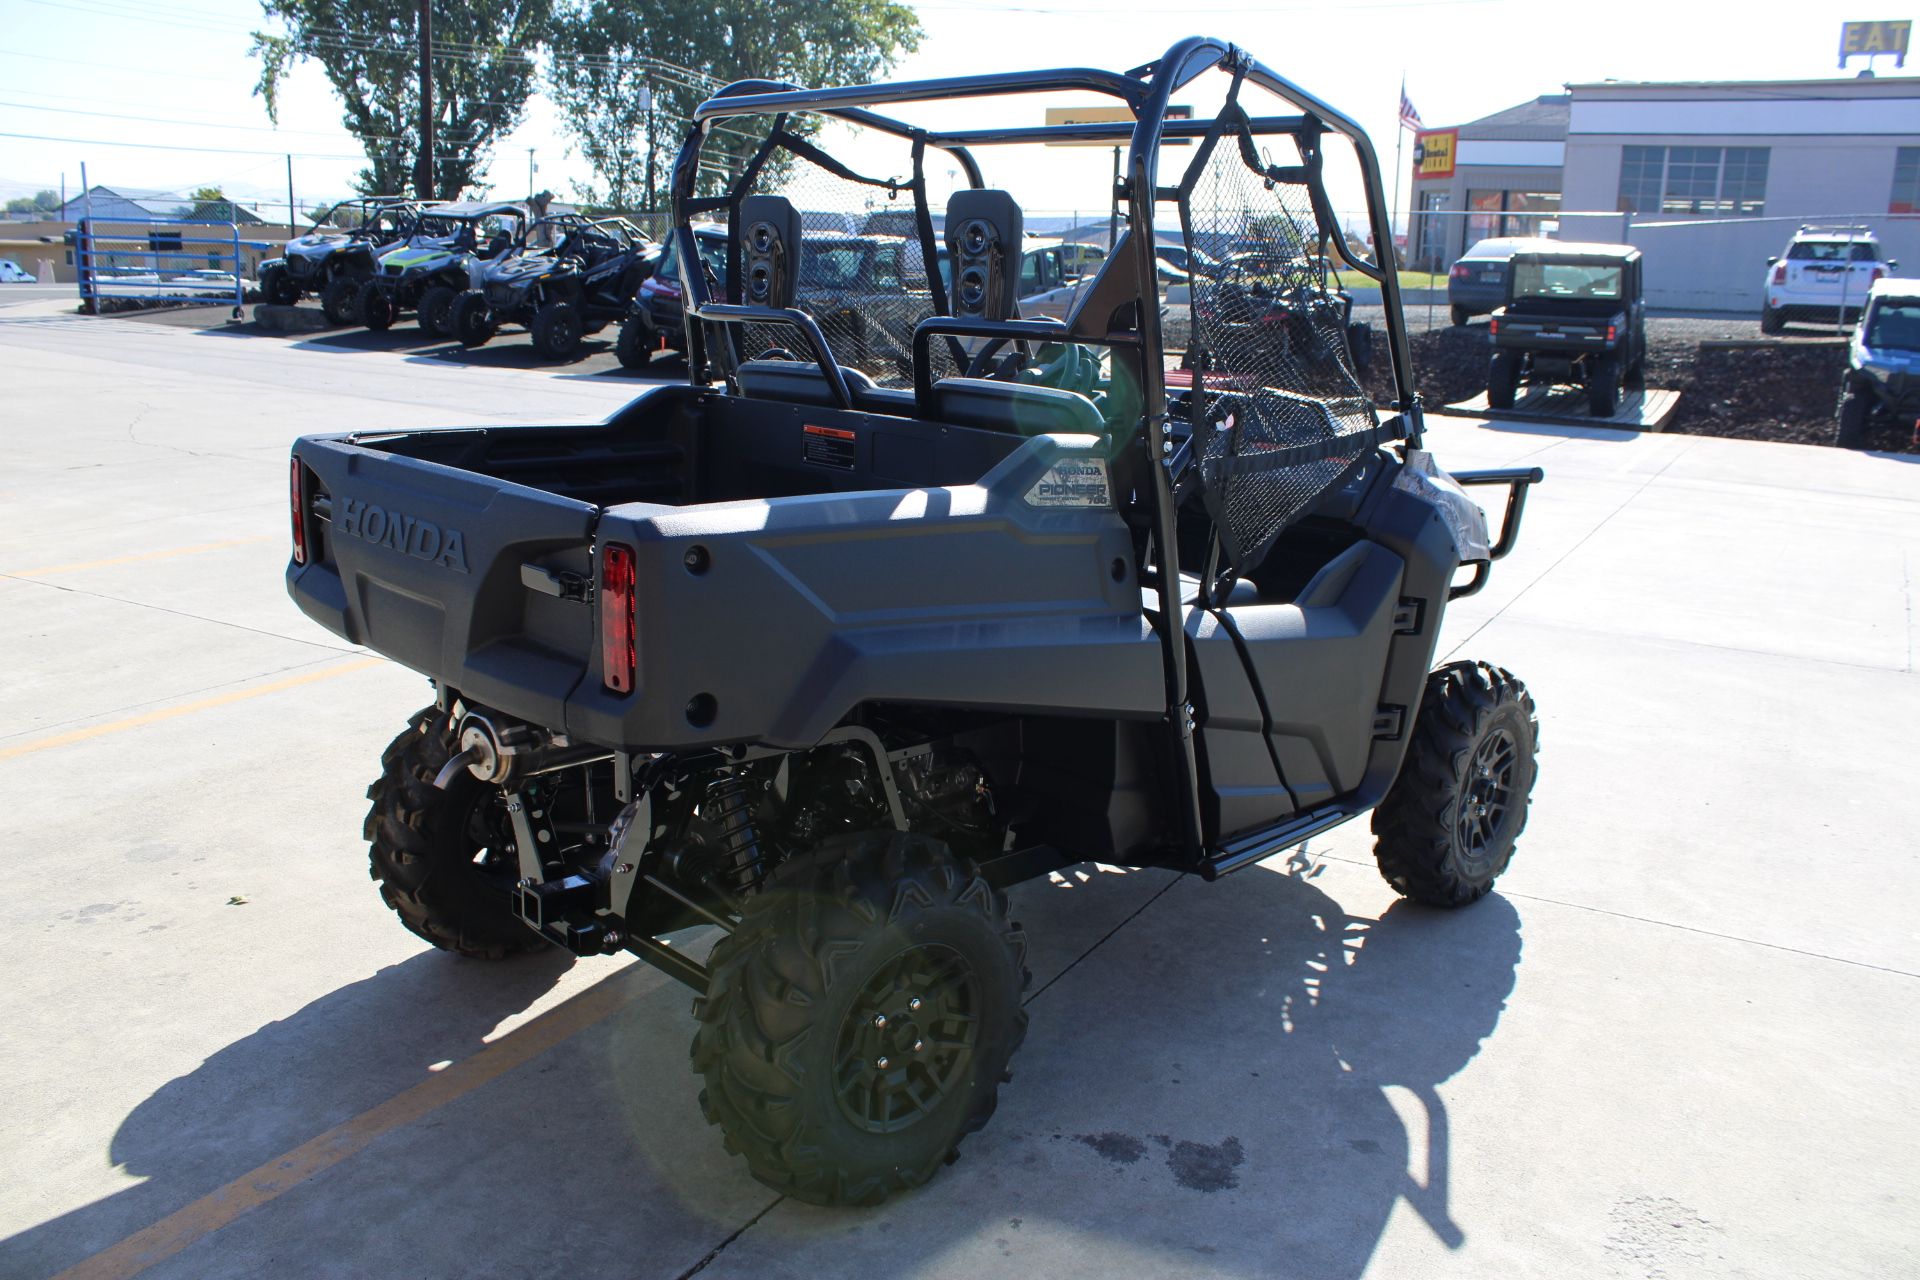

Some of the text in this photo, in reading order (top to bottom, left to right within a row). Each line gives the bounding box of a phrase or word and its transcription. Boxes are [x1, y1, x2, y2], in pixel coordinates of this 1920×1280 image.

[1843, 23, 1908, 51] EAT
[1058, 466, 1103, 476] HONDA
[1039, 484, 1107, 496] PIONEER
[1088, 496, 1107, 505] 700
[338, 497, 471, 575] HONDA
